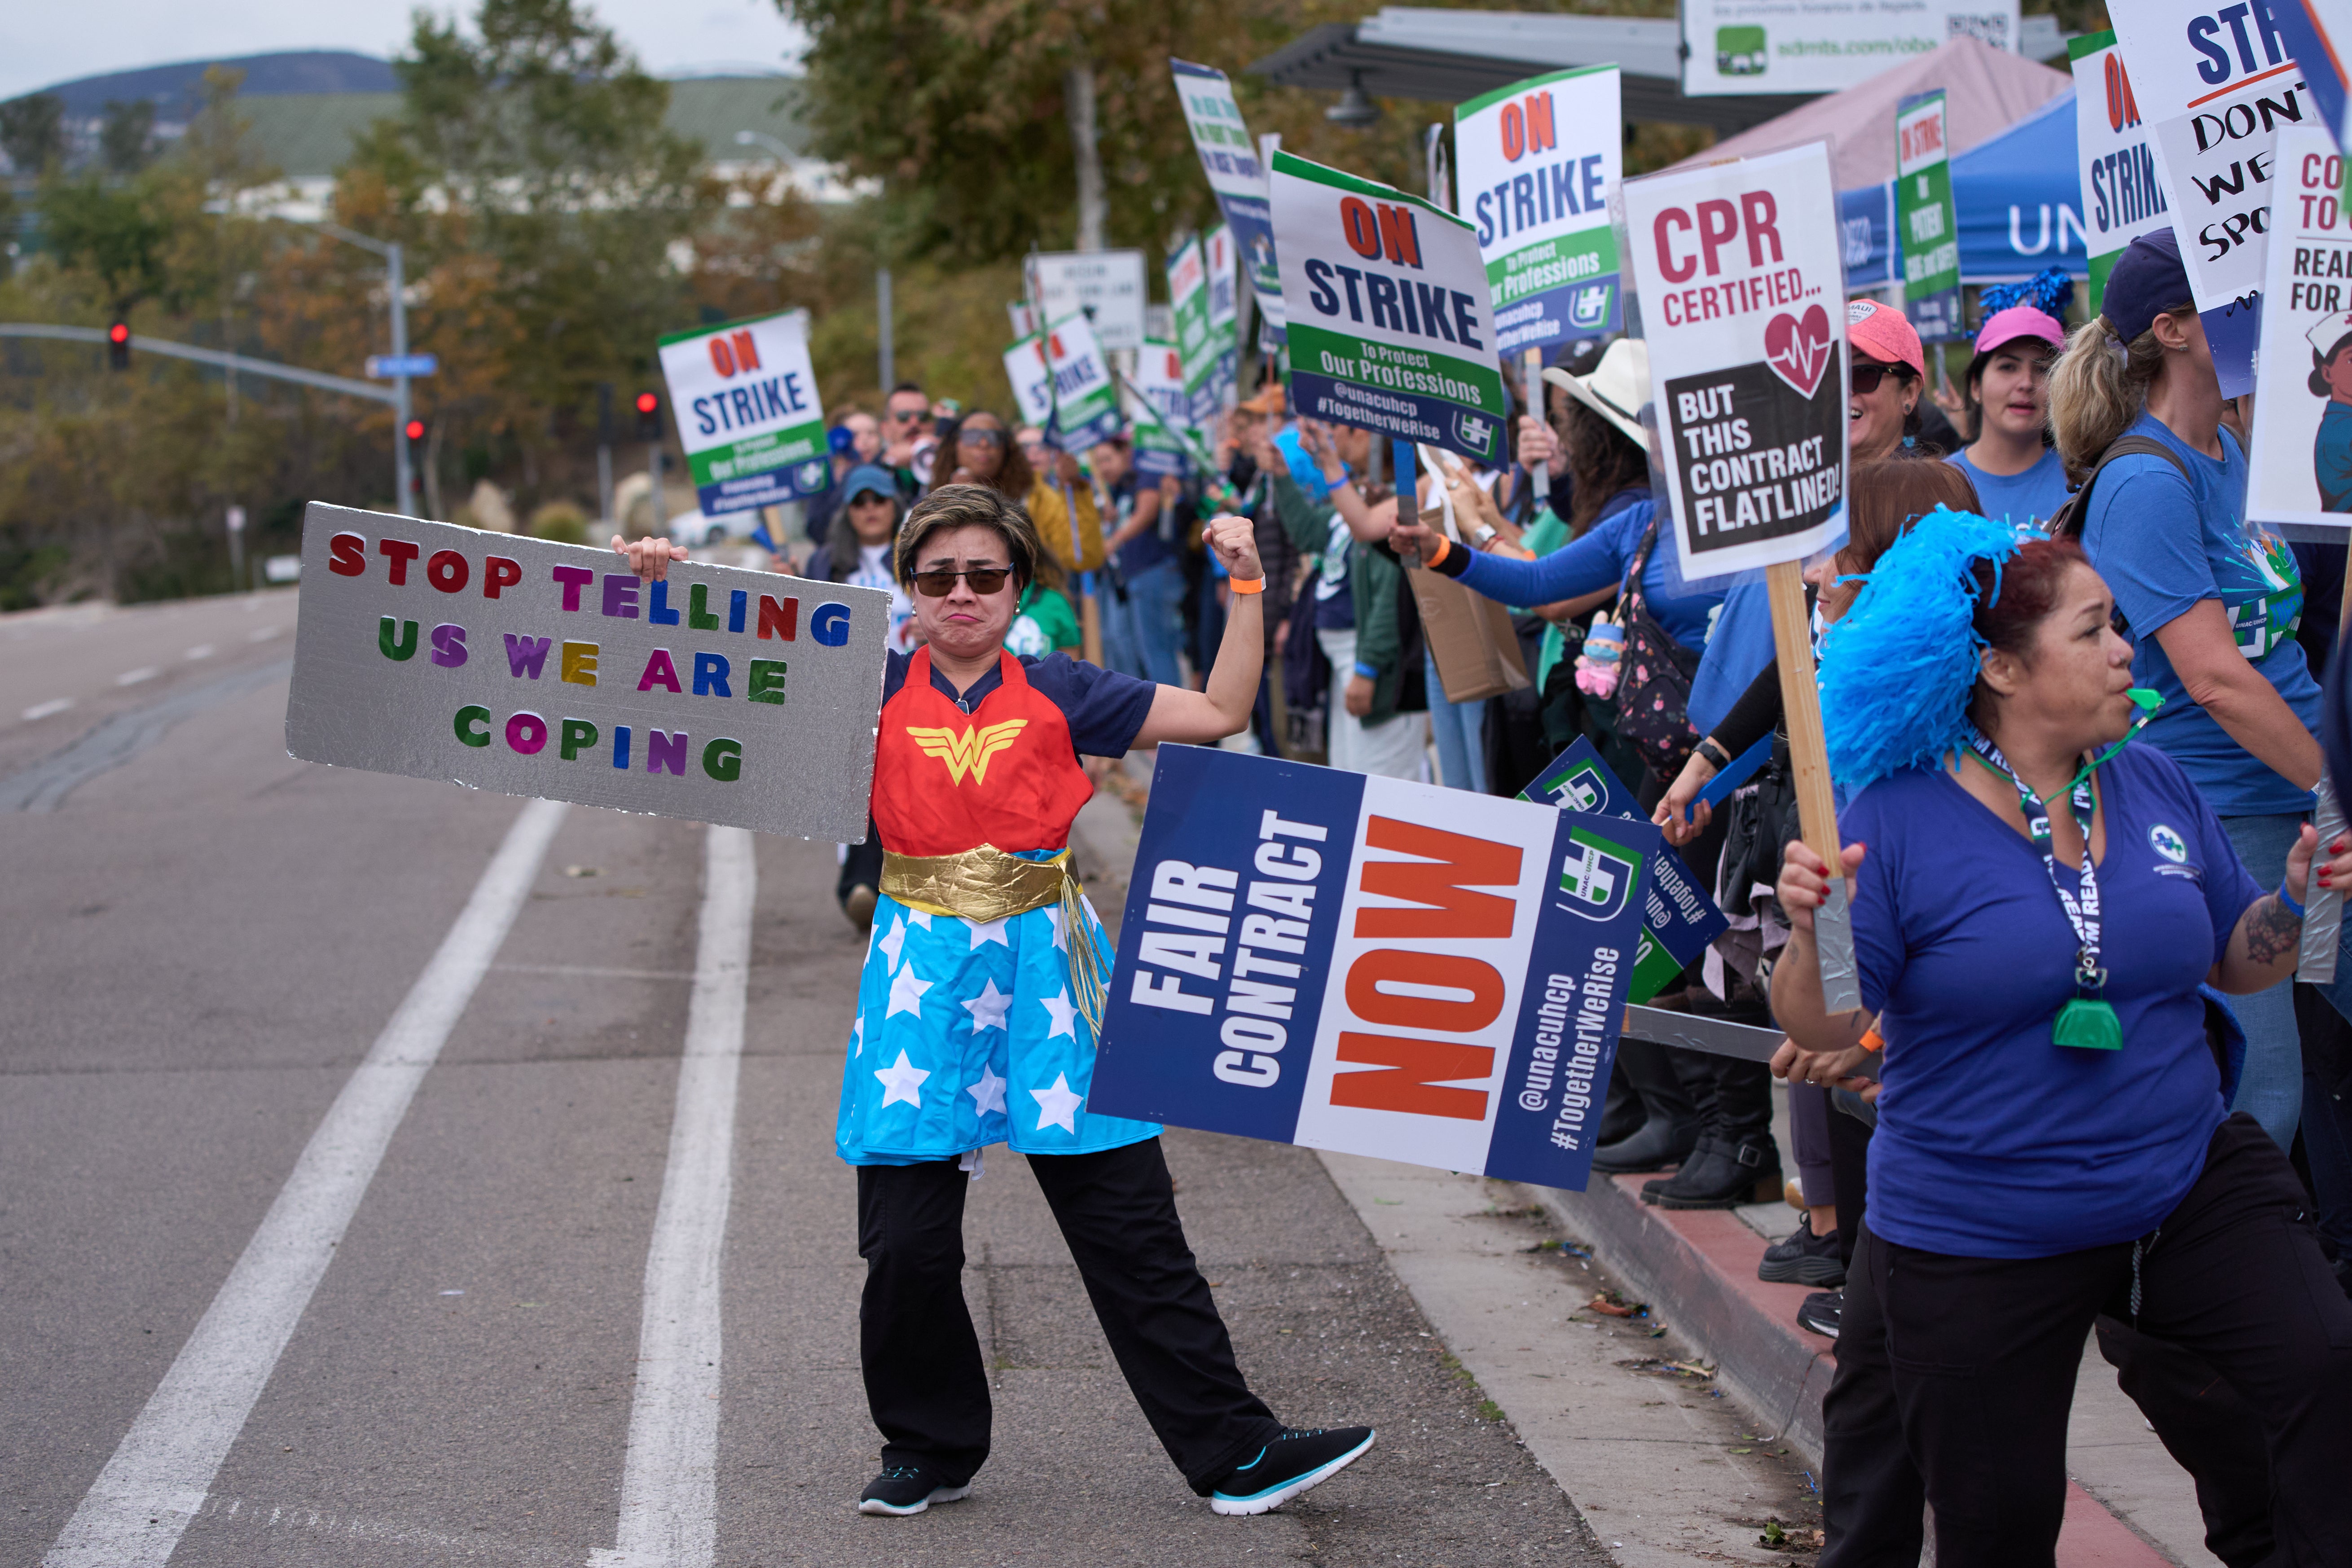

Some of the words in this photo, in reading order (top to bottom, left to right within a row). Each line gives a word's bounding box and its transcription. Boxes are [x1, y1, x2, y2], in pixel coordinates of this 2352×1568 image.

[1500, 91, 1557, 163] ON
[1475, 154, 1606, 249] STRIKE
[2092, 142, 2168, 233] STRIK
[2191, 150, 2275, 205] WE
[1340, 197, 1423, 270] ON
[1653, 190, 1784, 284] CPR
[2299, 194, 2338, 231] TO
[1490, 282, 1503, 306] ur
[1504, 251, 1600, 301] Professions
[1518, 242, 1556, 267] Protect
[1304, 258, 1484, 351] STRIKE
[1663, 268, 1821, 327] CERTIFIED...
[2290, 282, 2340, 312] FOR
[708, 327, 761, 378] ON
[1320, 350, 1358, 378] Our
[1360, 360, 1482, 405] Professions
[1361, 342, 1377, 359] To
[1380, 345, 1429, 369] Protect
[693, 373, 807, 435] STRIKE
[1317, 396, 1440, 440] #TogetherWeRise
[1335, 382, 1418, 418] @unacuhcp
[1677, 384, 1734, 425] BUT
[1683, 418, 1751, 459] THIS
[1690, 435, 1823, 495] CONTRACT
[1694, 462, 1840, 536] FLATLINED!
[329, 531, 522, 600] STOP
[552, 565, 851, 648] TELLING
[2235, 617, 2267, 628] UNAC/UHCP
[378, 615, 468, 668] US
[503, 632, 600, 687] WE
[637, 648, 787, 706] ARE
[453, 704, 742, 782] COPING
[1581, 850, 1594, 897] UNAC/UHCP
[1130, 859, 1239, 1016] FAIR
[1213, 809, 1329, 1089] CONTRACT
[1329, 814, 1525, 1122] NOW
[1518, 973, 1574, 1112] @unacuhcp
[1549, 946, 1619, 1151] #TogetherWeRise
